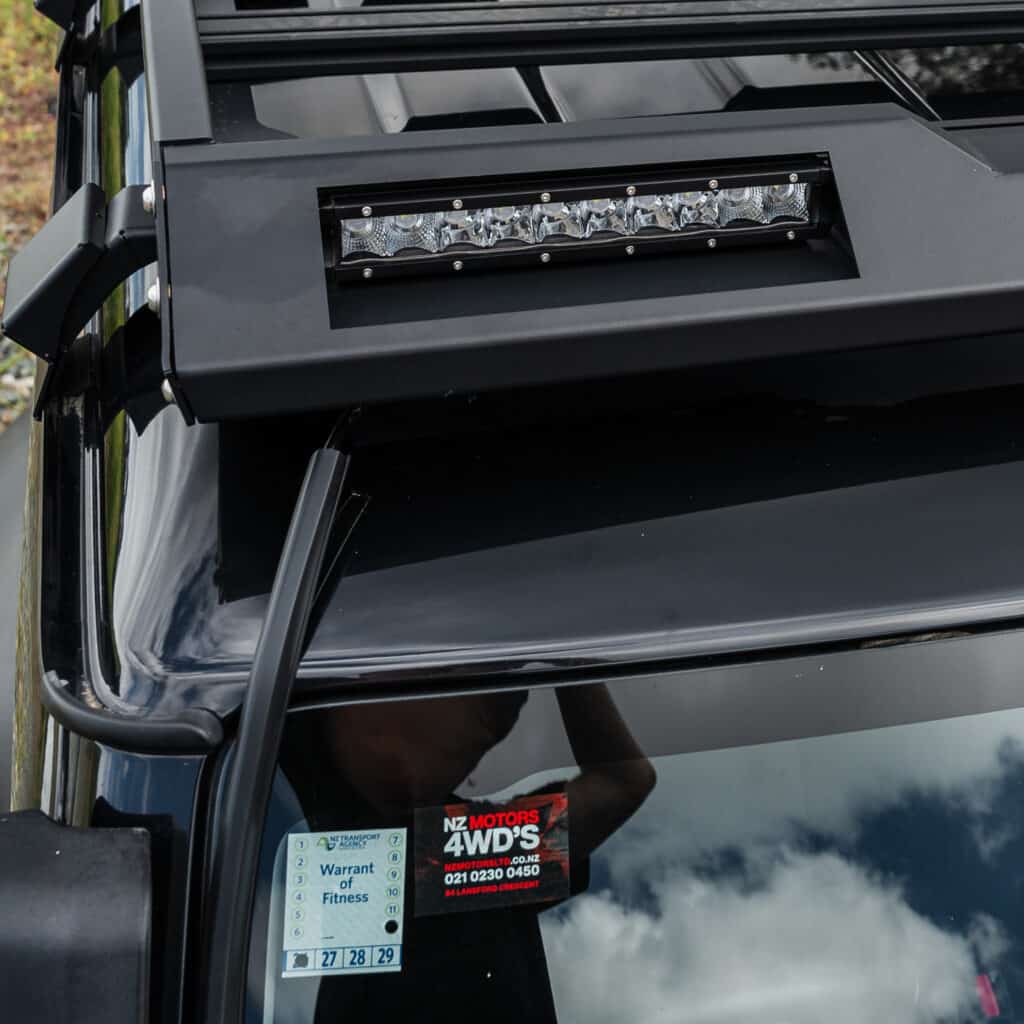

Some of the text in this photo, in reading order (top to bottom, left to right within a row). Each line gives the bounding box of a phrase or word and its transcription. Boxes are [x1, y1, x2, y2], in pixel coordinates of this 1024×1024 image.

[443, 809, 540, 833] NZ MOTORS
[320, 861, 375, 876] Warrant
[443, 864, 541, 885] 021 0230 0450
[339, 876, 354, 889] of
[322, 892, 369, 904] Fitness
[389, 888, 398, 896] 10
[389, 905, 396, 913] 11
[321, 950, 337, 968] 27
[349, 949, 366, 966] 28
[377, 947, 394, 964] 29
